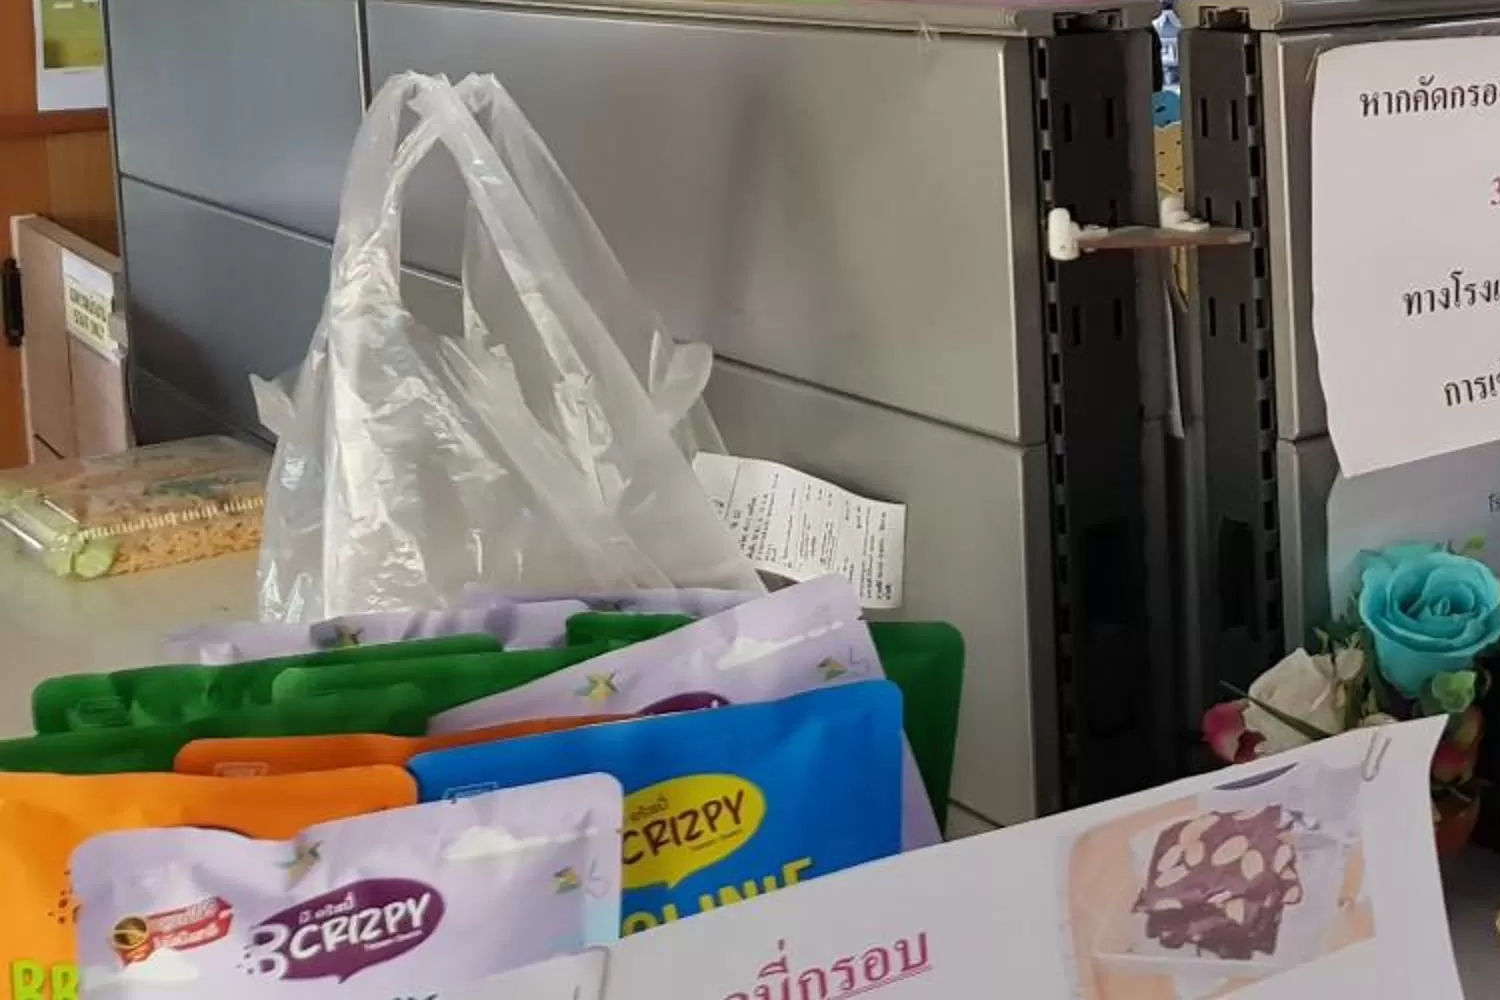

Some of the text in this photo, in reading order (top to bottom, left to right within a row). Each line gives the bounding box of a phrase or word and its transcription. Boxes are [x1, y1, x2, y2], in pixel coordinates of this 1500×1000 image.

[289, 892, 432, 960] CRIZPY
[722, 930, 929, 1000] มี่กรอบ
